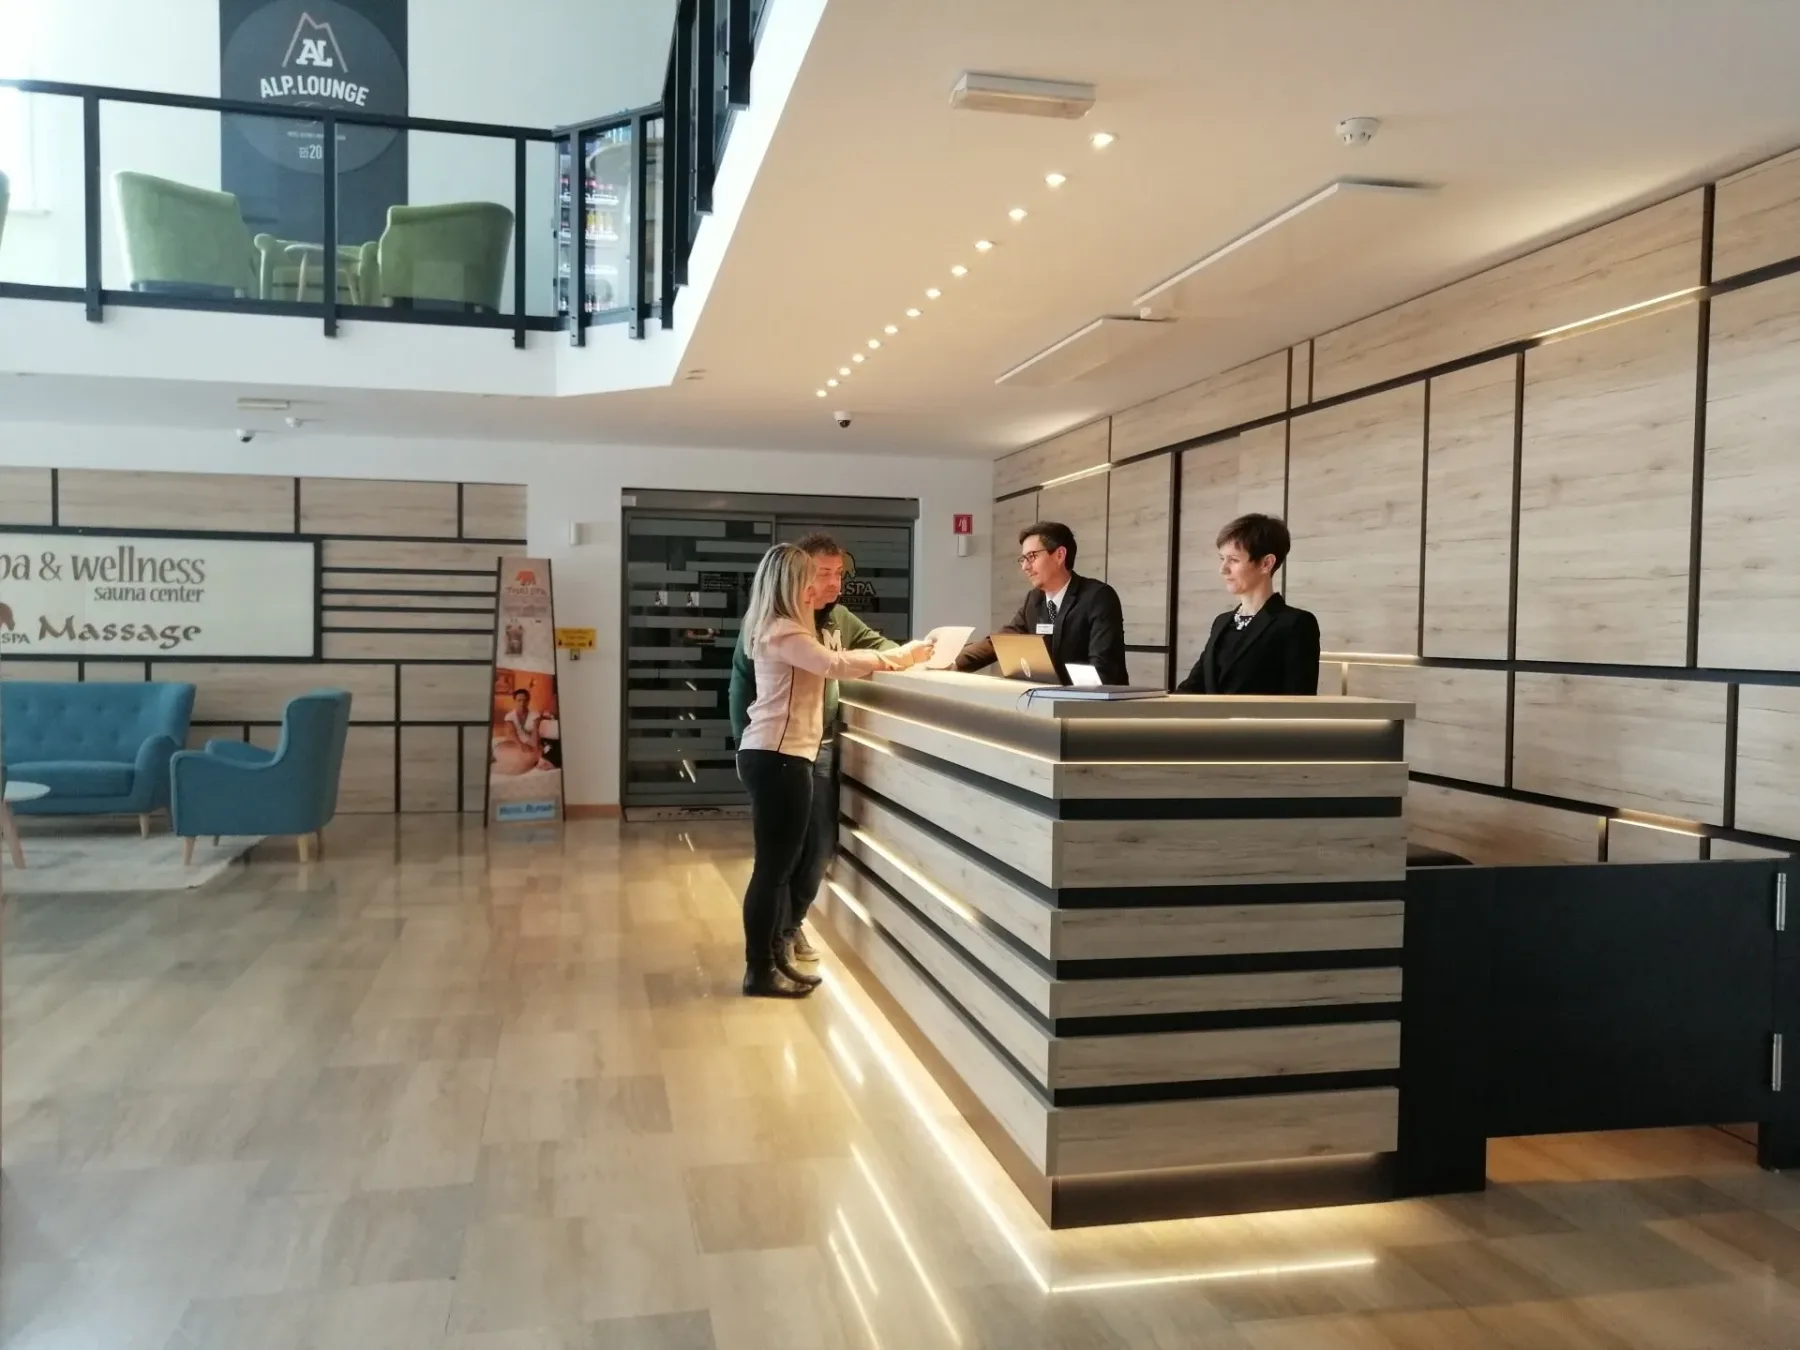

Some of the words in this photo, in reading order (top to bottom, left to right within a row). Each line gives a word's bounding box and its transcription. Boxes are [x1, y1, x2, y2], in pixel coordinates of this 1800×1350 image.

[296, 38, 333, 67] AL
[39, 551, 62, 581] &
[71, 545, 206, 584] wellness
[94, 585, 146, 602] sauna
[150, 585, 205, 602] center
[845, 582, 876, 596] SPA
[1, 633, 30, 645] SPA
[38, 615, 202, 650] Massage
